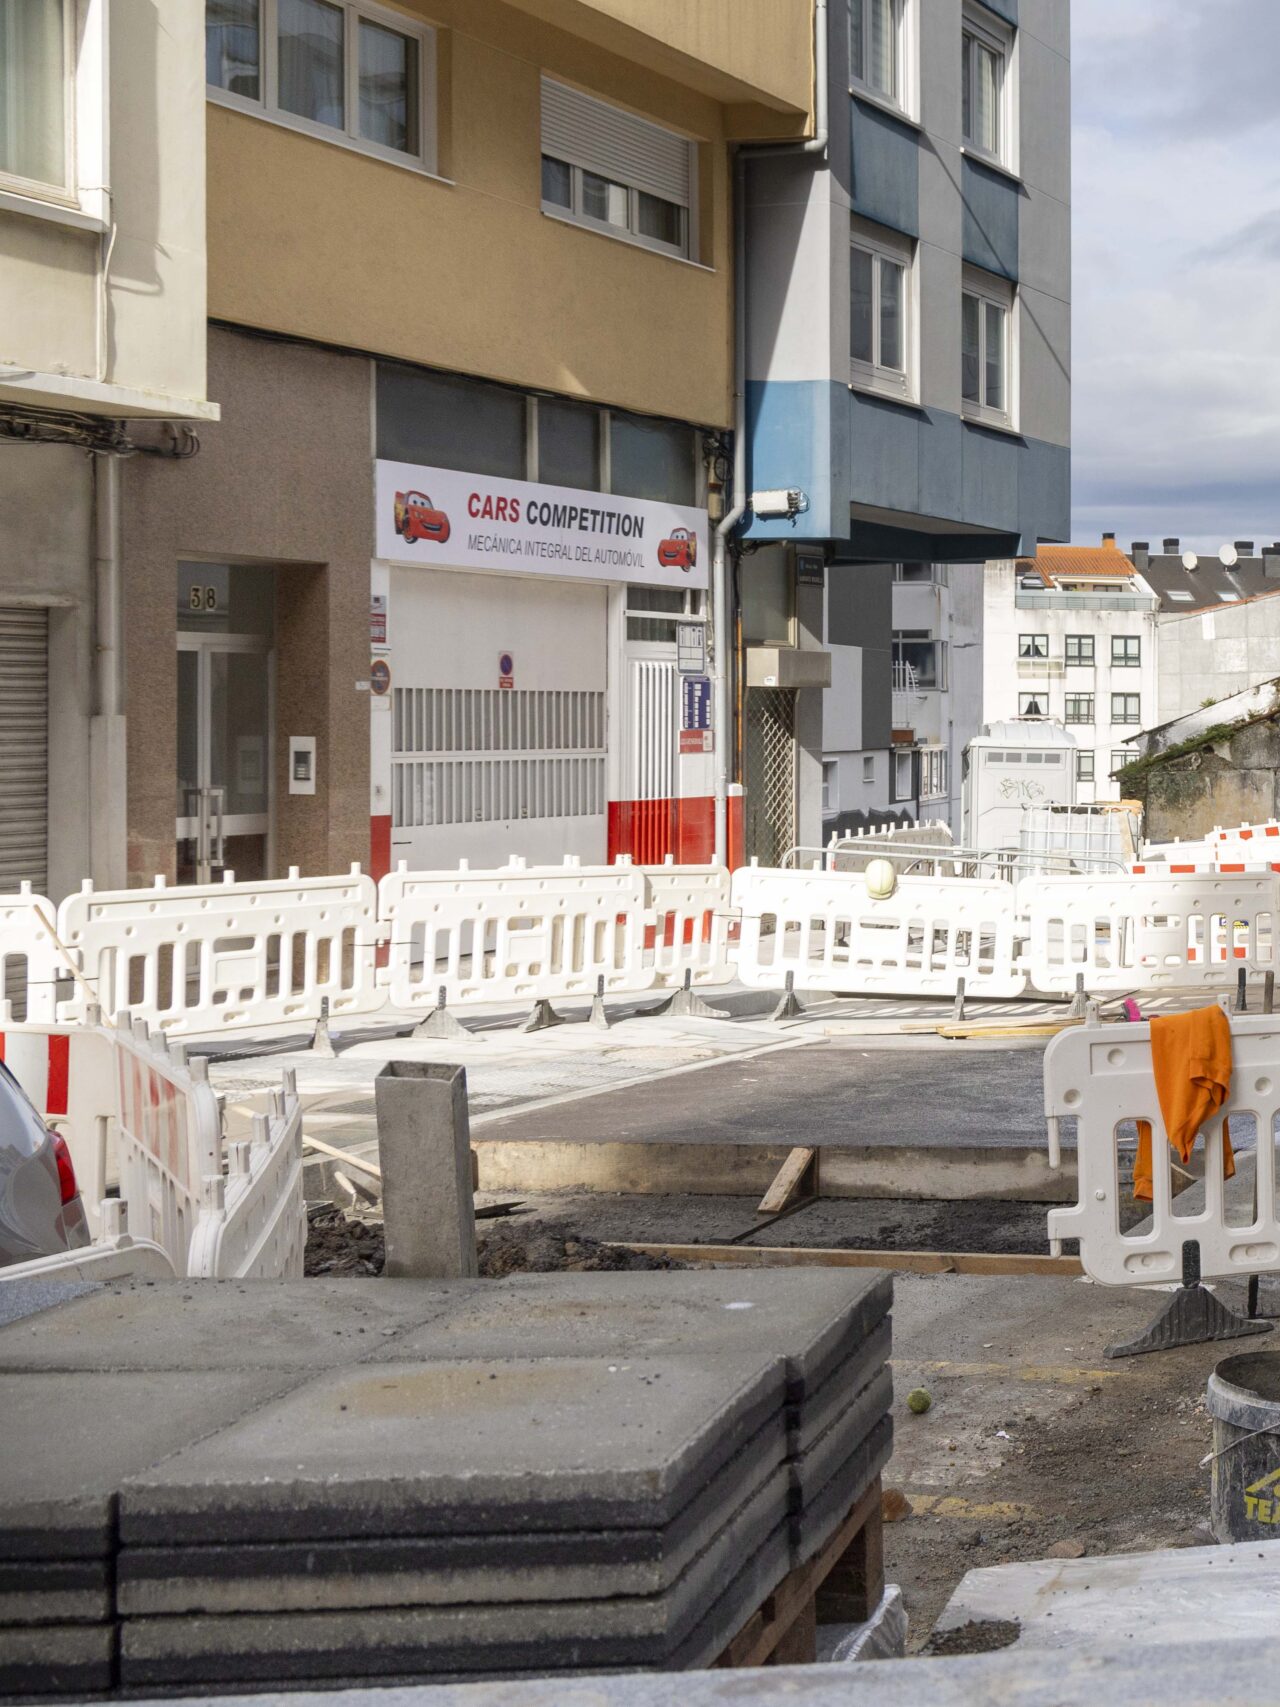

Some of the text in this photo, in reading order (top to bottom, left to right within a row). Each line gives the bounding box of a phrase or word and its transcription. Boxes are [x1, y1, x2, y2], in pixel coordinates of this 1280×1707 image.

[467, 492, 645, 538] CARS COMPETITION
[467, 533, 645, 568] MECÁNICA INTEGRAL DEL AUTOMÓVIL
[191, 587, 216, 608] 38
